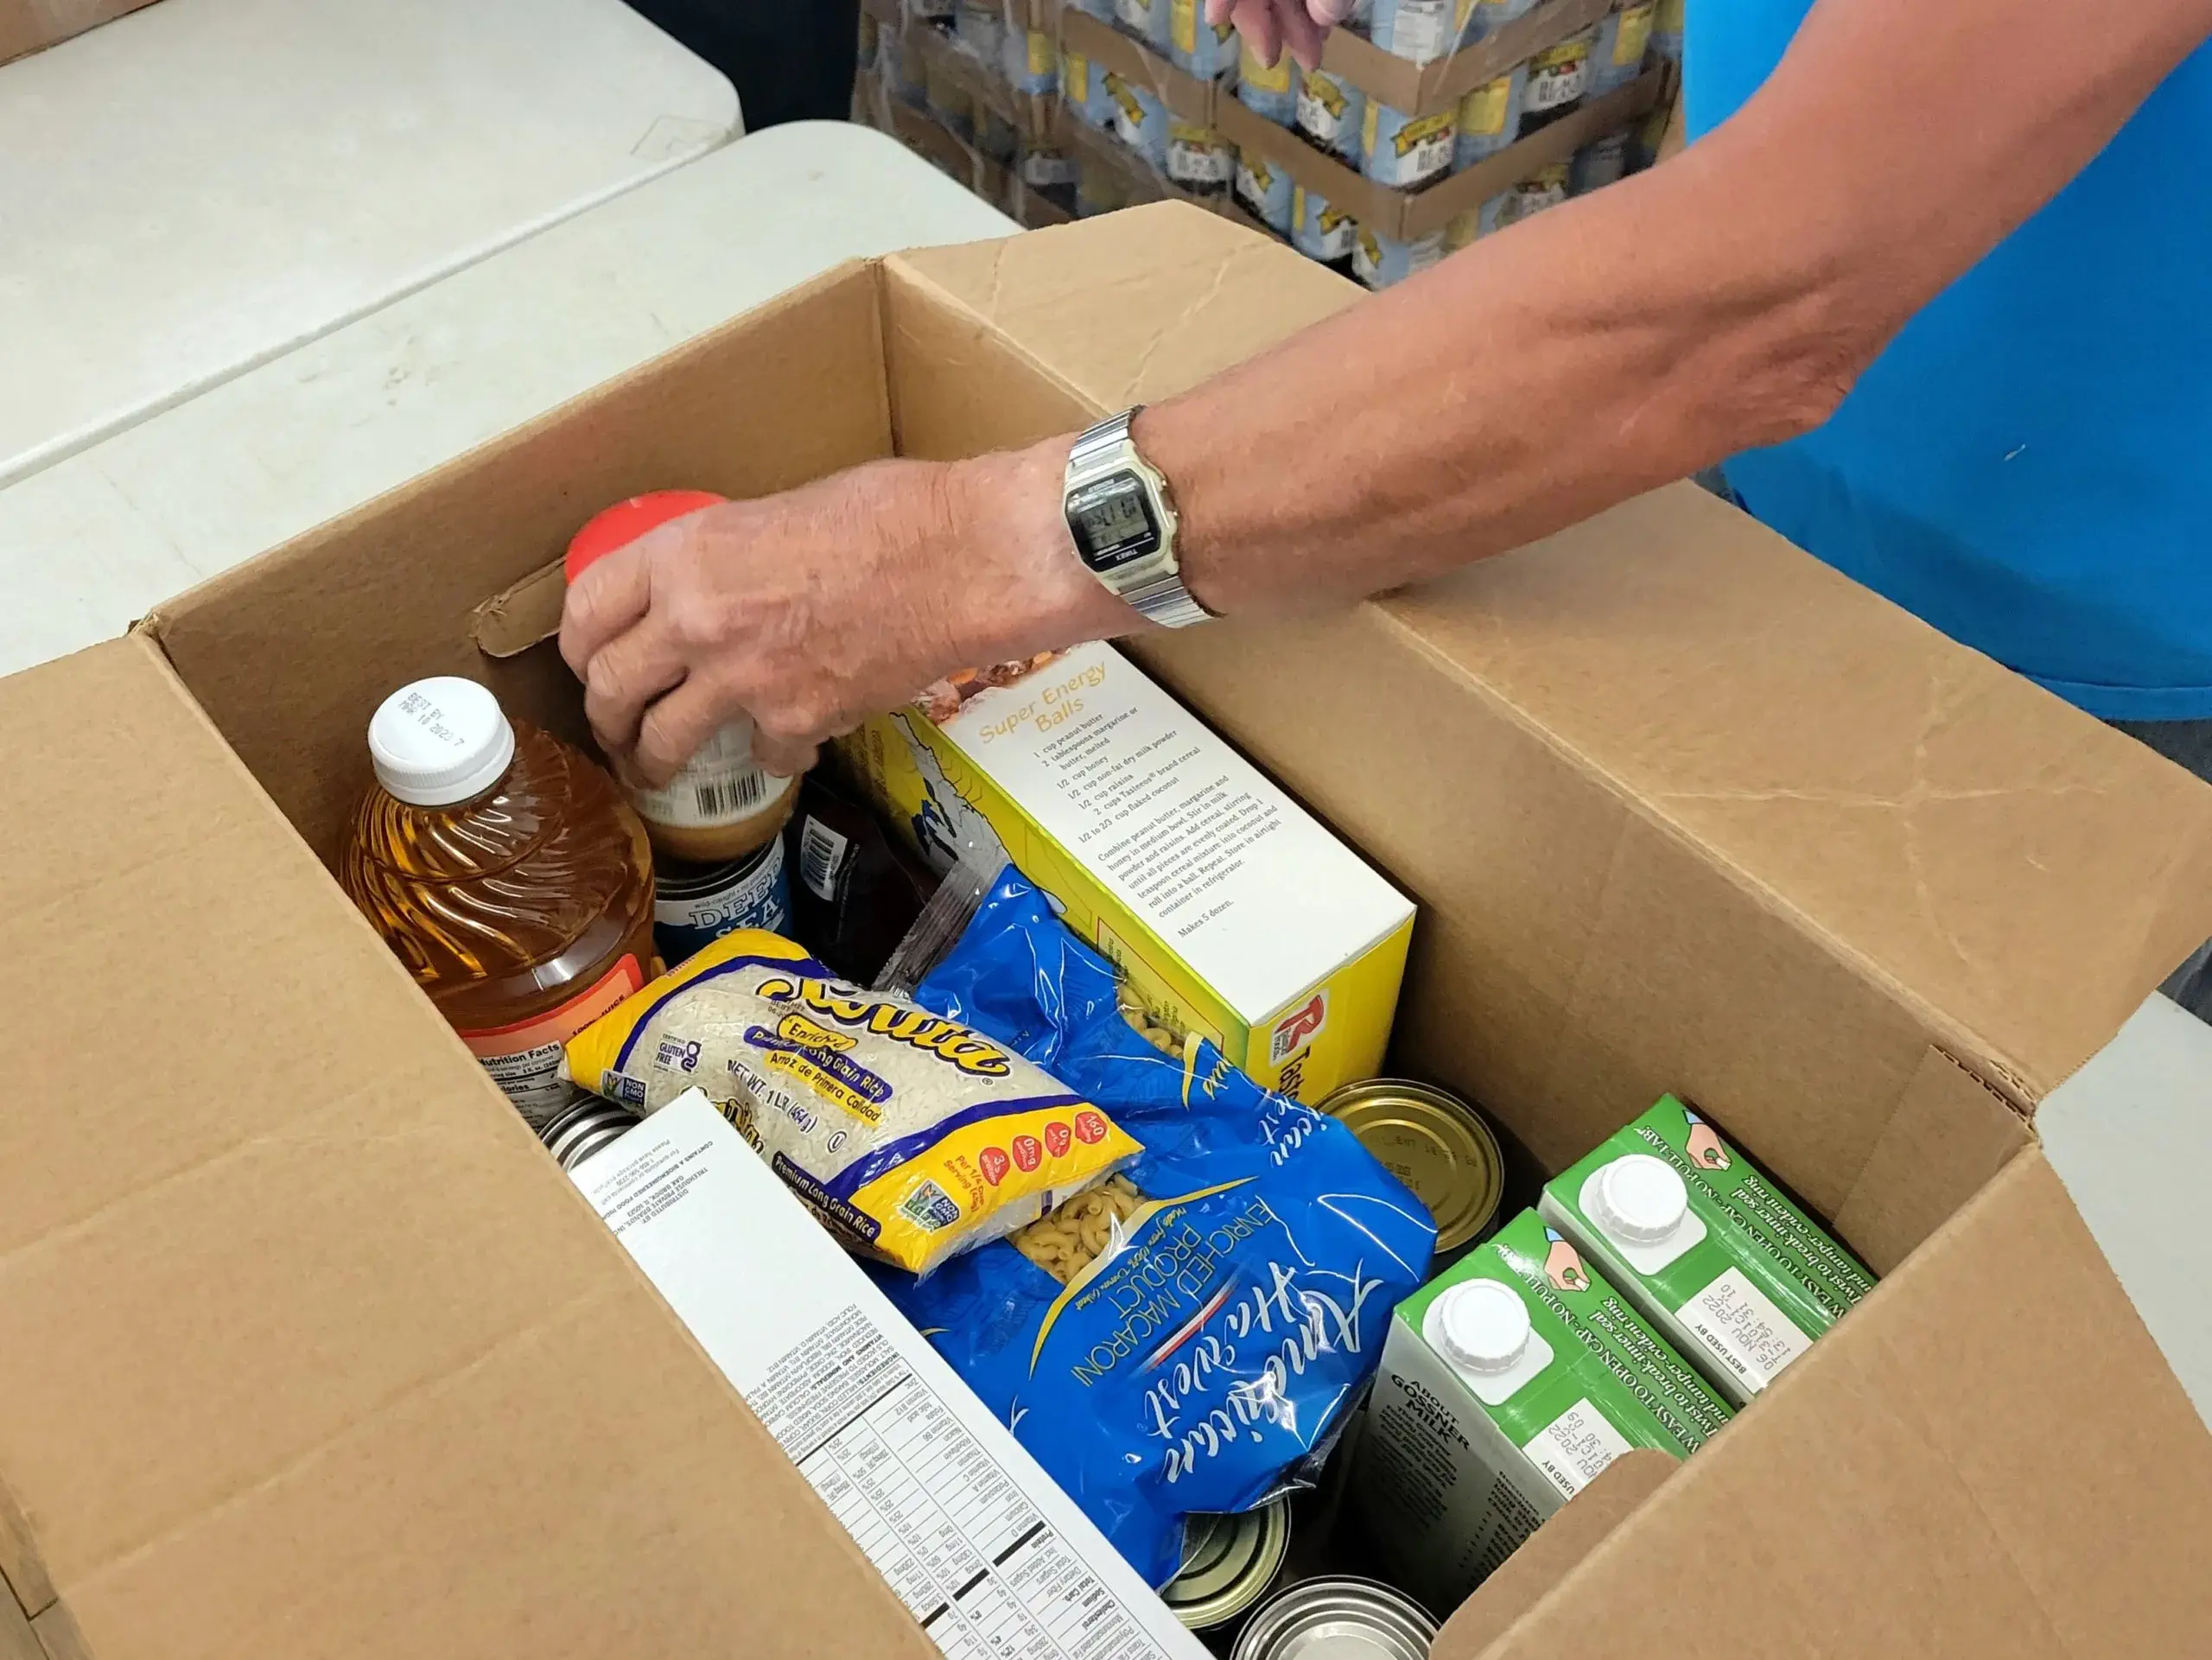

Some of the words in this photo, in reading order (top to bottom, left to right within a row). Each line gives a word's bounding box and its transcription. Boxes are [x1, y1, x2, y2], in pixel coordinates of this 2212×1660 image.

[407, 691, 431, 710] BEST
[429, 708, 444, 720] BY
[979, 701, 1046, 743] Super
[1041, 661, 1105, 704] Energy
[1034, 698, 1084, 732] Balls
[1042, 742, 1057, 753] cup
[1056, 726, 1082, 746] peanut
[1078, 713, 1103, 729] butter
[1051, 734, 1093, 761] tablespoons
[1092, 712, 1129, 735] margarine
[1128, 706, 1138, 715] or
[1058, 754, 1086, 770] butter,
[1084, 736, 1110, 755] melted
[1066, 788, 1081, 799] 1/2
[1082, 779, 1097, 791] cup
[1096, 762, 1123, 781] non-fat
[1122, 754, 1136, 765] dry
[1135, 745, 1153, 758] milk
[1151, 729, 1177, 748] powder
[1056, 778, 1070, 789] 1/2
[1071, 769, 1086, 780] cup
[1084, 755, 1109, 772] honey
[1092, 807, 1102, 816] 2
[1103, 796, 1122, 809] cups
[1155, 759, 1179, 775] brand
[1178, 746, 1201, 762] cereal
[1077, 831, 1092, 843] 1/2
[1098, 817, 1113, 830] 2/3
[1114, 809, 1129, 820] cup
[1127, 792, 1152, 811] flaked
[1151, 776, 1179, 796] coconut
[1097, 838, 1131, 861] Combine
[1130, 821, 1156, 842] peanut
[1153, 807, 1180, 824] butter,
[1179, 785, 1215, 809] margarine
[1214, 774, 1229, 786] and
[1106, 853, 1131, 871] honey
[1139, 829, 1169, 850] medium
[1166, 816, 1189, 831] bowl.
[1185, 807, 1202, 819] Stir
[1209, 791, 1228, 804] milk
[690, 856, 784, 930] DEEP
[1158, 892, 1193, 918] container
[1191, 886, 1204, 894] in
[1202, 859, 1244, 888] refrigerator.
[1177, 919, 1204, 938] Makes
[1200, 913, 1210, 921] 5
[1208, 900, 1234, 917] dozen.
[527, 1041, 561, 1059] Facts
[656, 1053, 671, 1066] FREE
[659, 1042, 686, 1058] GLUTEN
[625, 1086, 644, 1097] GMO
[626, 1079, 645, 1091] NON
[770, 1053, 798, 1068] Arroz
[798, 1065, 812, 1078] de
[813, 1072, 844, 1099] Primera
[846, 1094, 881, 1122] Calidad
[1637, 1126, 1668, 1153] TAB!
[1664, 1151, 1698, 1180] PULL
[775, 1155, 808, 1191] Premium
[808, 1183, 830, 1206] Long
[830, 1198, 854, 1223] Grain
[853, 1217, 875, 1237] Rice
[1694, 1180, 1718, 1198] NO
[1731, 1188, 1758, 1208] seal
[1744, 1175, 1768, 1199] ring
[1720, 1202, 1746, 1230] CAP
[1755, 1207, 1787, 1237] inner
[1176, 1202, 1274, 1296] ENRICHED
[1744, 1225, 1780, 1261] OPEN
[1766, 1199, 1850, 1273] tamper-evident
[1784, 1233, 1819, 1266] break
[1109, 1224, 1201, 1319] PRODUCT
[1777, 1254, 1798, 1277] TO
[1817, 1263, 1831, 1275] to
[1524, 1271, 1555, 1304] PULL
[1796, 1275, 1831, 1307] EASY
[1828, 1275, 1861, 1305] Twist
[1551, 1297, 1574, 1325] NO
[1589, 1311, 1617, 1332] seal
[1603, 1297, 1627, 1321] ring
[1701, 1294, 1732, 1324] 2022
[1071, 1293, 1179, 1387] MACARONI
[1575, 1329, 1603, 1352] CAP
[1694, 1323, 1708, 1336] BY
[1141, 1261, 1296, 1437] Harvest
[1612, 1333, 1645, 1362] inner
[1706, 1333, 1727, 1356] USED
[1161, 1258, 1384, 1484] American
[1599, 1351, 1637, 1386] OPEN
[1624, 1322, 1708, 1403] tamper-evident
[1725, 1354, 1746, 1374] BEST
[1755, 1352, 1774, 1371] 06
[1642, 1360, 1675, 1396] break
[893, 1402, 908, 1415] B12
[905, 1387, 928, 1405] Vitamin
[1409, 1380, 1459, 1425] ABOUT
[1634, 1385, 1655, 1408] TO
[1674, 1393, 1688, 1405] to
[1391, 1374, 1470, 1451] GOSSNER
[1406, 1399, 1452, 1444] MILK
[1652, 1405, 1686, 1437] EASY
[1685, 1405, 1718, 1438] Twist
[943, 1435, 972, 1460] Riboflavin
[1541, 1460, 1555, 1472] BY
[978, 1479, 1009, 1504] Potassium
[1004, 1489, 1019, 1503] Iron
[1553, 1471, 1574, 1494] USED
[1004, 1500, 1028, 1522] Calcium
[1015, 1512, 1039, 1531] Vitamin
[1010, 1528, 1019, 1537] D
[1030, 1529, 1053, 1549] Protein
[1033, 1565, 1058, 1585] Sugars
[1055, 1555, 1071, 1569] Total
[1058, 1565, 1082, 1585] Dietary
[1046, 1581, 1063, 1598] Fiber
[1061, 1587, 1080, 1602] Carb.
[1077, 1574, 1095, 1591] Total
[1081, 1587, 1105, 1607] Sodium
[1077, 1599, 1118, 1630] Cholesterol
